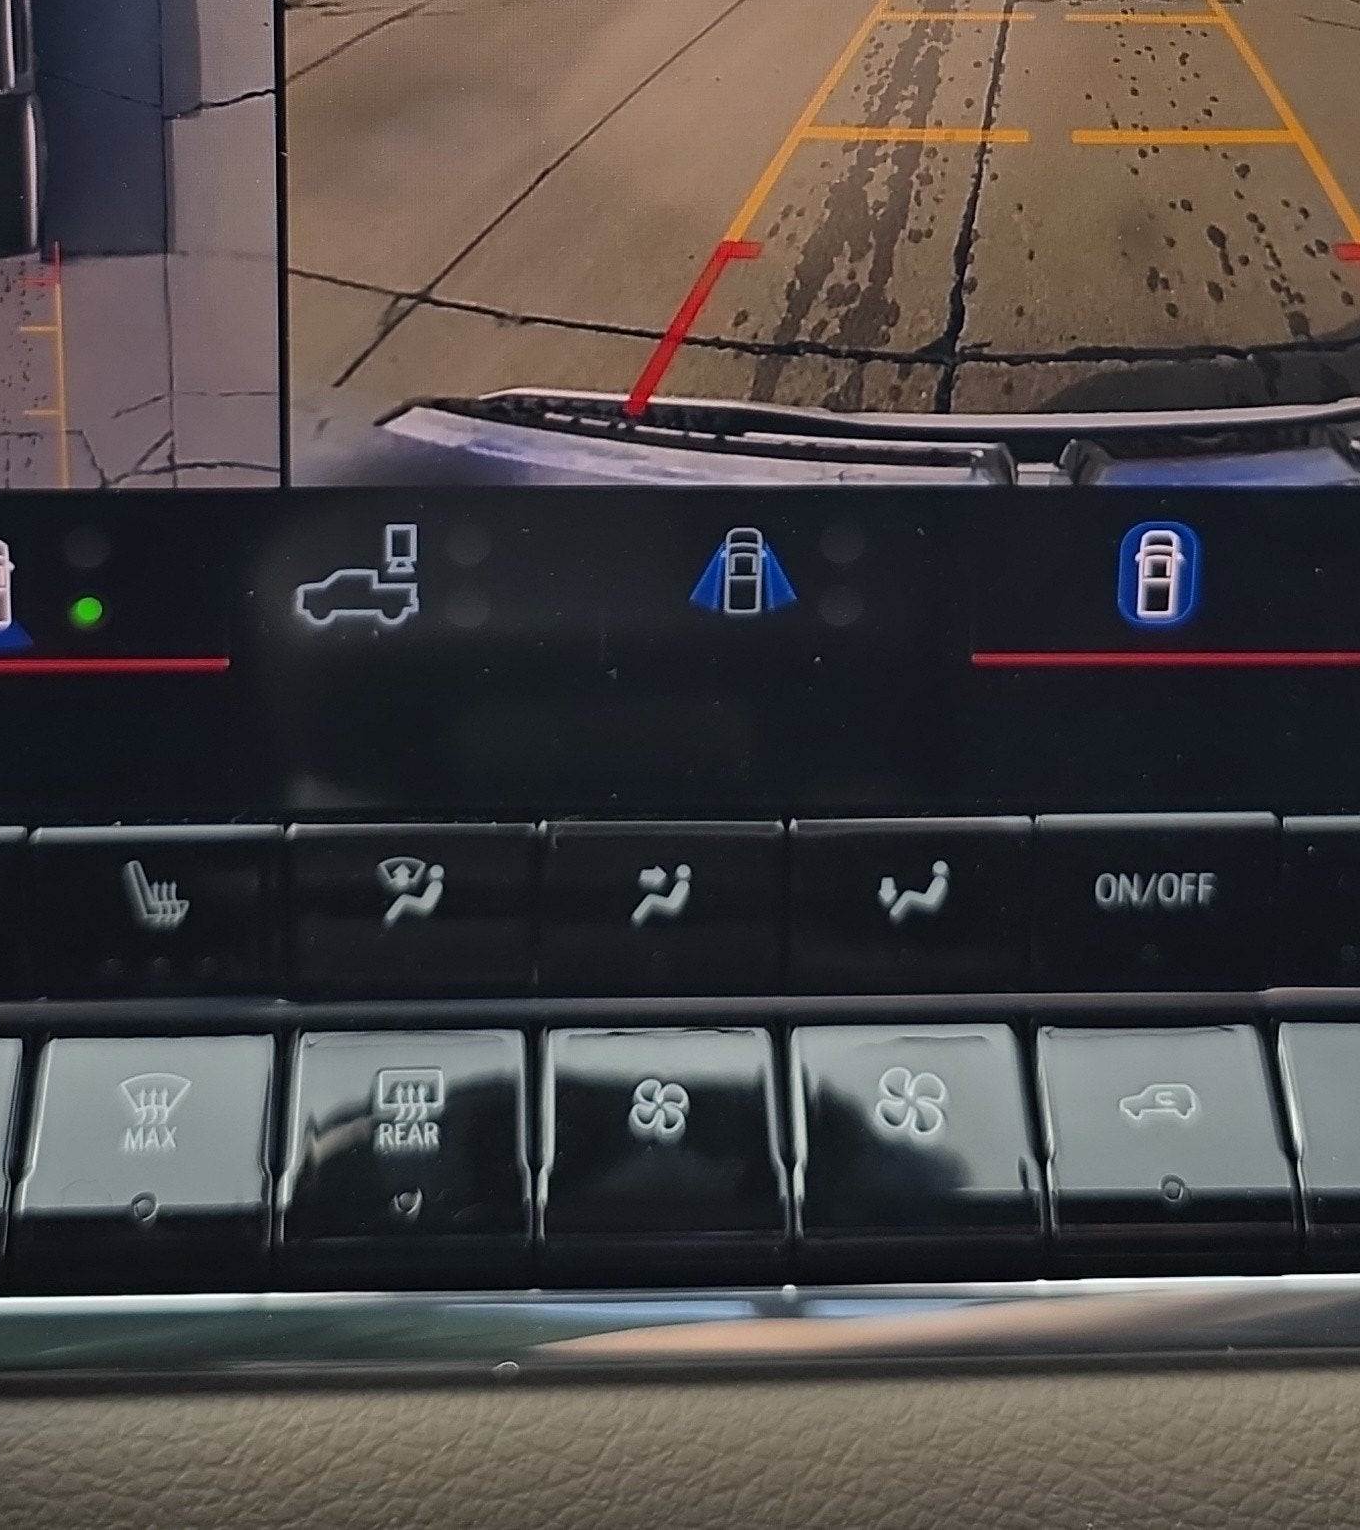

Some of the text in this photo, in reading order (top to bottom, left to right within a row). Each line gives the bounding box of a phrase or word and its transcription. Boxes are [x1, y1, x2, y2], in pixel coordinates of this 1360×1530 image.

[1095, 872, 1216, 905] ON/OFF
[124, 1126, 177, 1151] MAX
[378, 1122, 440, 1148] REAR
